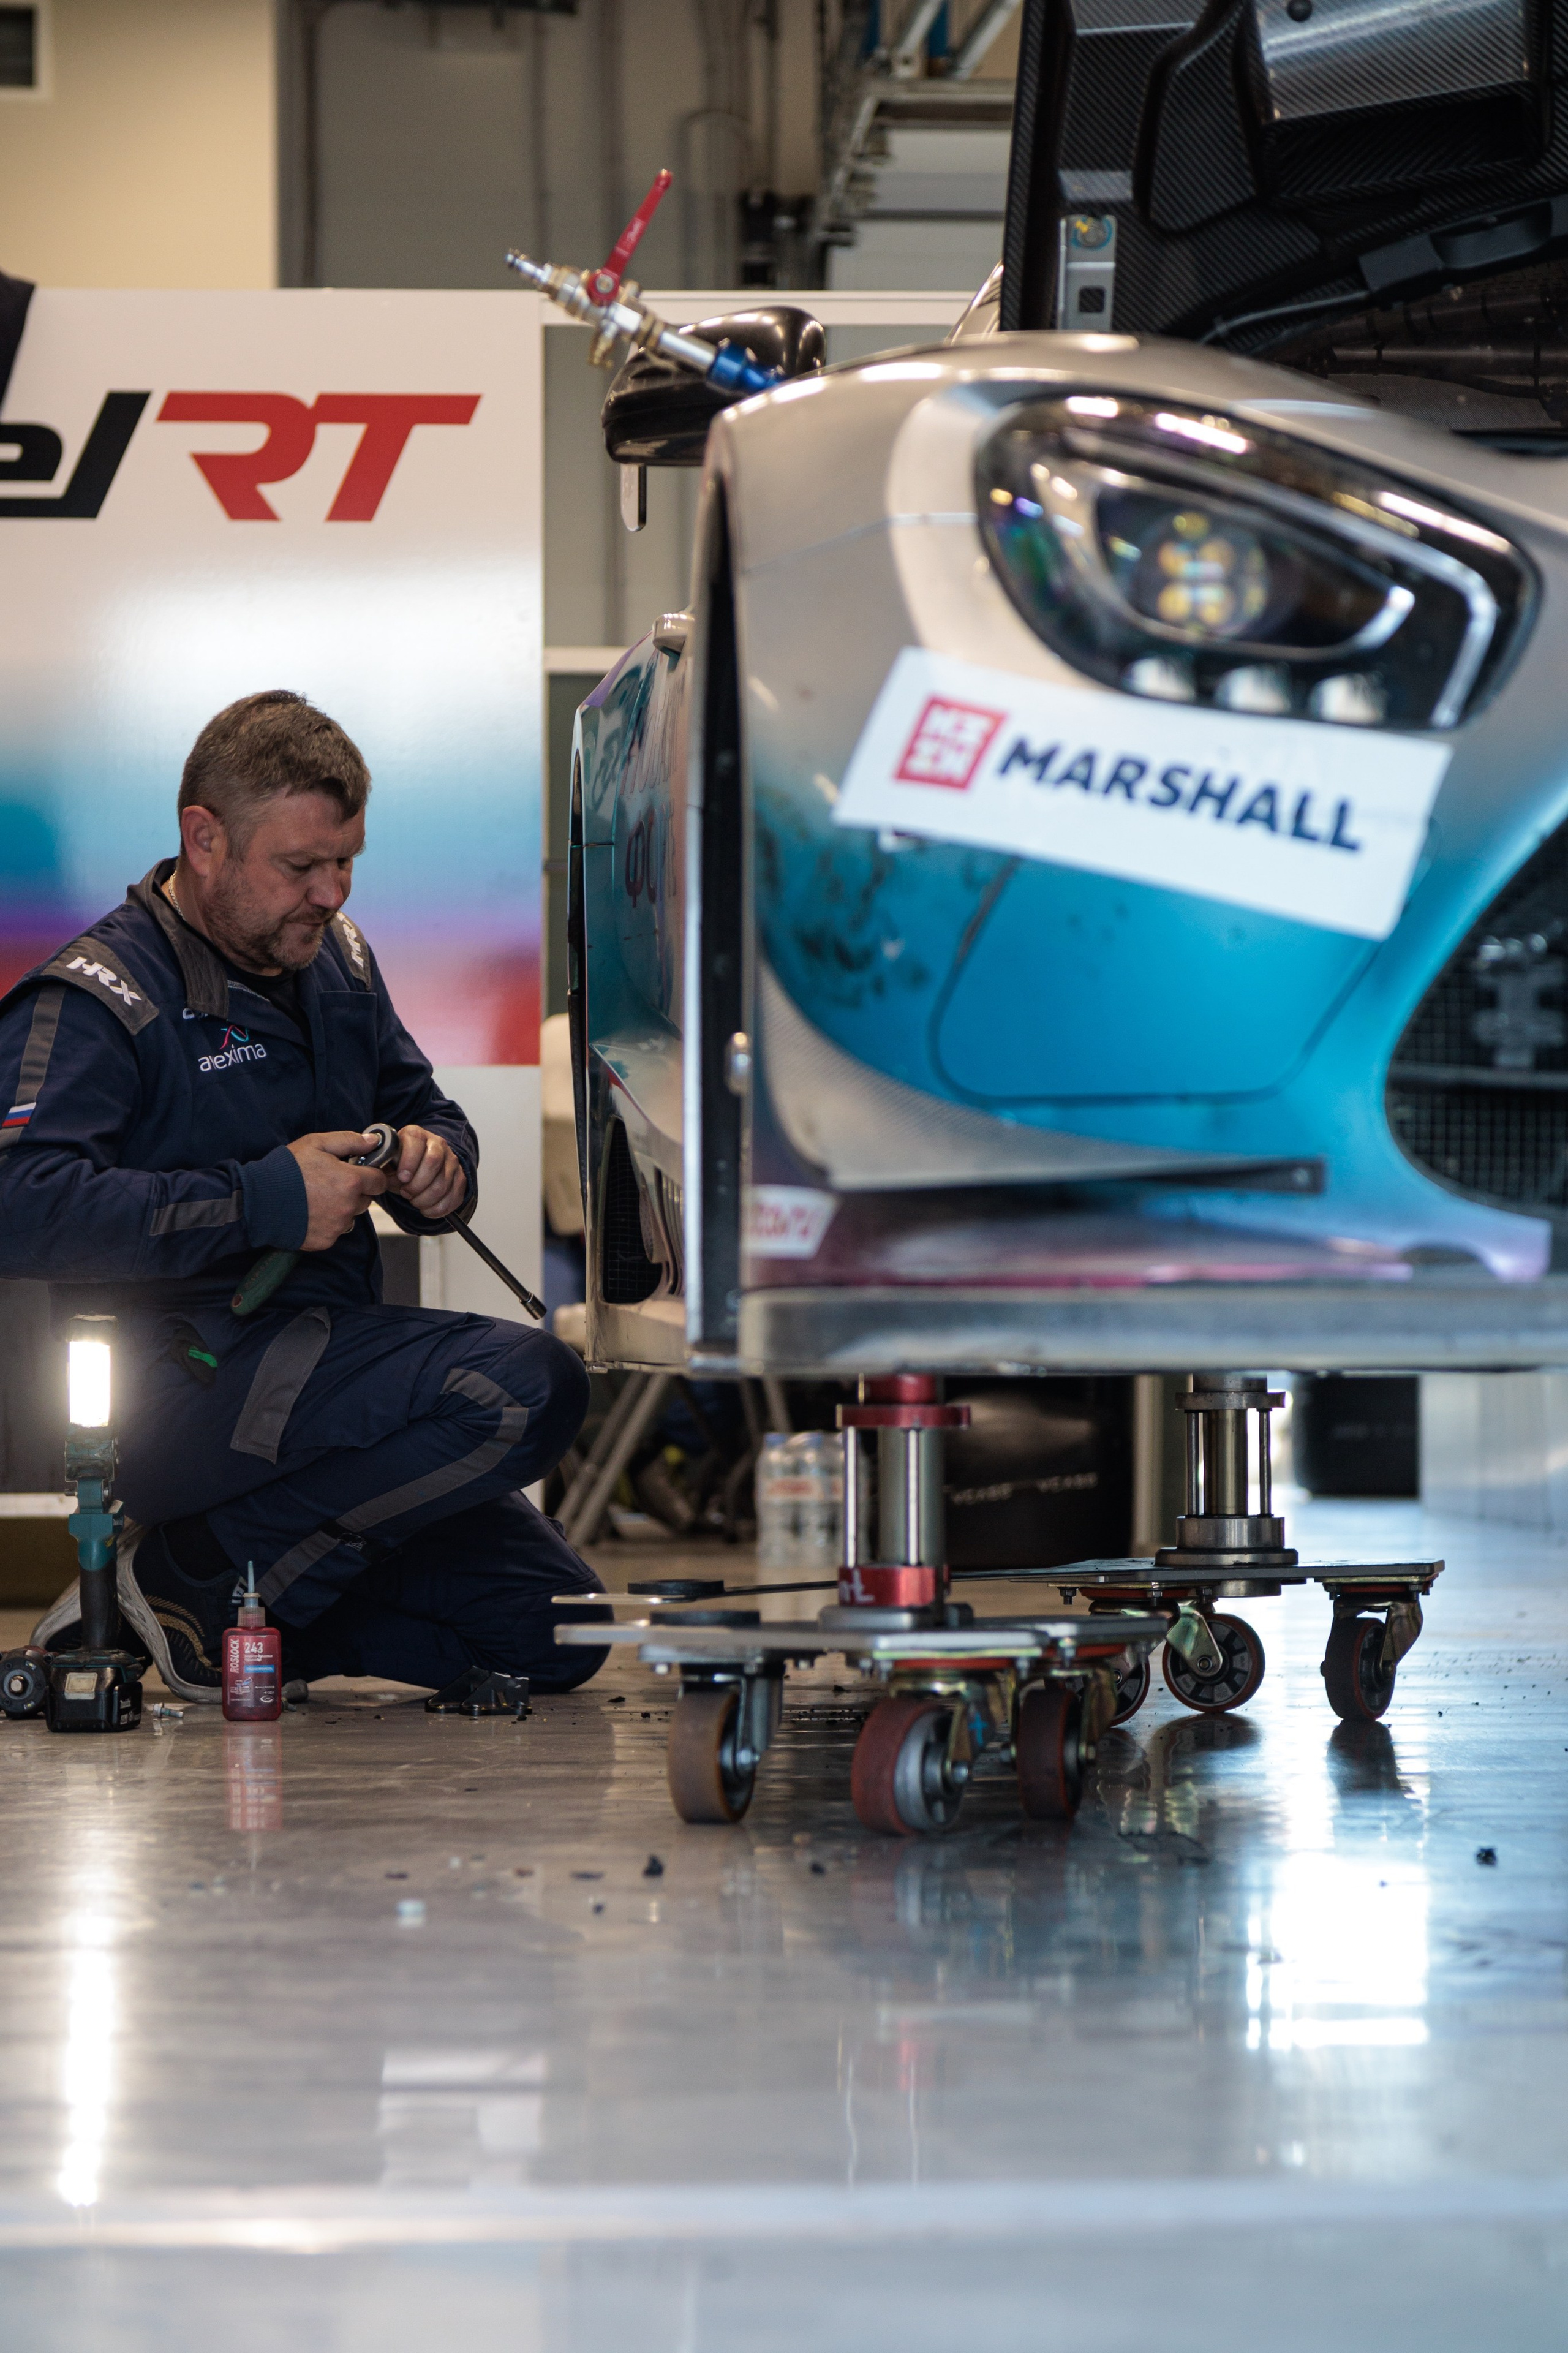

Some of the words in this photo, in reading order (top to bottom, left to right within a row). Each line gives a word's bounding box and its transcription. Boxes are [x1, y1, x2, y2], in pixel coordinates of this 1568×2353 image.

[997, 735, 1359, 852] MARSHALL
[66, 956, 142, 1007] HRX
[198, 1043, 267, 1071] alexima
[230, 1638, 239, 1674] ROSLOCK
[244, 1642, 263, 1654] 243
